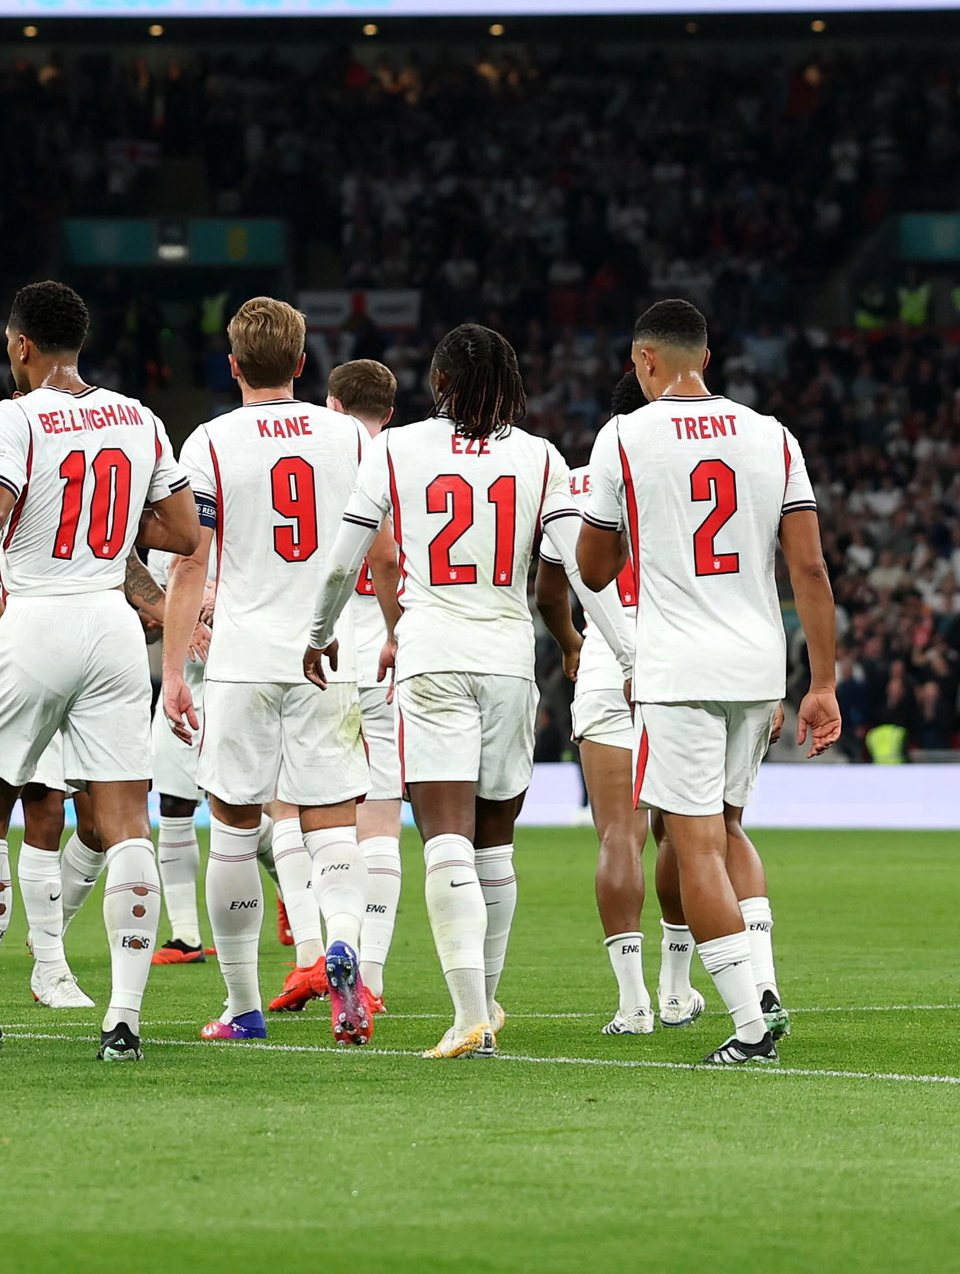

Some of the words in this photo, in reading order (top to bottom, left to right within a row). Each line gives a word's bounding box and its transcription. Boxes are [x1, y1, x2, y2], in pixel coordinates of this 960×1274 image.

[38, 404, 144, 435] BELLINGHAM
[257, 416, 313, 438] KANE
[671, 415, 737, 439] TRENT
[451, 434, 491, 454] EZE
[52, 448, 132, 560] 10
[271, 456, 318, 562] 9
[690, 459, 740, 577] 2
[425, 474, 516, 586] 21
[321, 863, 350, 876] ENG
[230, 899, 258, 910] ENG
[366, 904, 387, 913] ENG
[122, 935, 150, 949] EG
[622, 945, 640, 955] ENG
[669, 942, 690, 952] ENG
